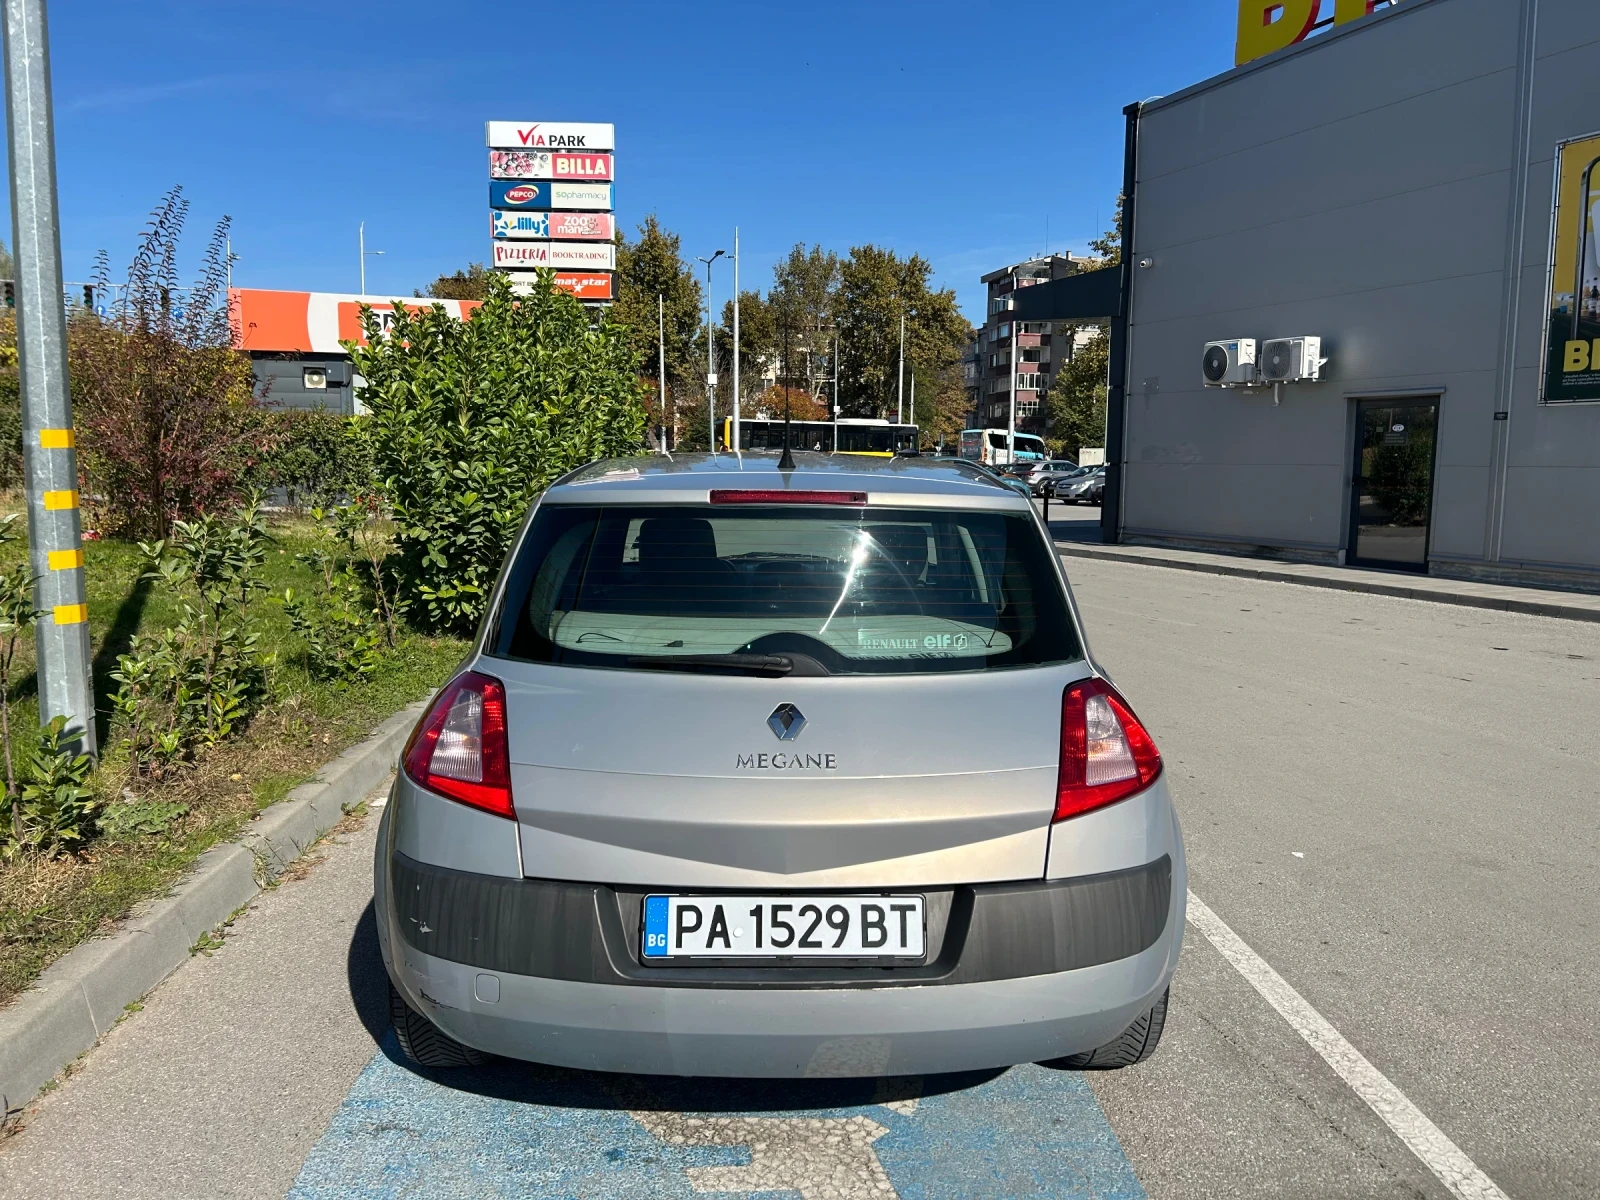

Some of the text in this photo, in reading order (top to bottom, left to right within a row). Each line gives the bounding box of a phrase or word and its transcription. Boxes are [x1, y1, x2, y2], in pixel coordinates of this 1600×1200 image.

[517, 124, 586, 147] VIA PARK
[556, 158, 607, 175] BILLA
[509, 190, 534, 198] PEPCO
[517, 217, 540, 234] lilly
[496, 246, 547, 261] PIZZERIA
[552, 251, 608, 260] BOOKTRADING
[581, 278, 609, 286] star
[863, 634, 951, 649] RENAULT elf
[735, 752, 838, 769] MEGANE
[675, 904, 917, 949] PA 1529 BT
[647, 933, 666, 947] BG
